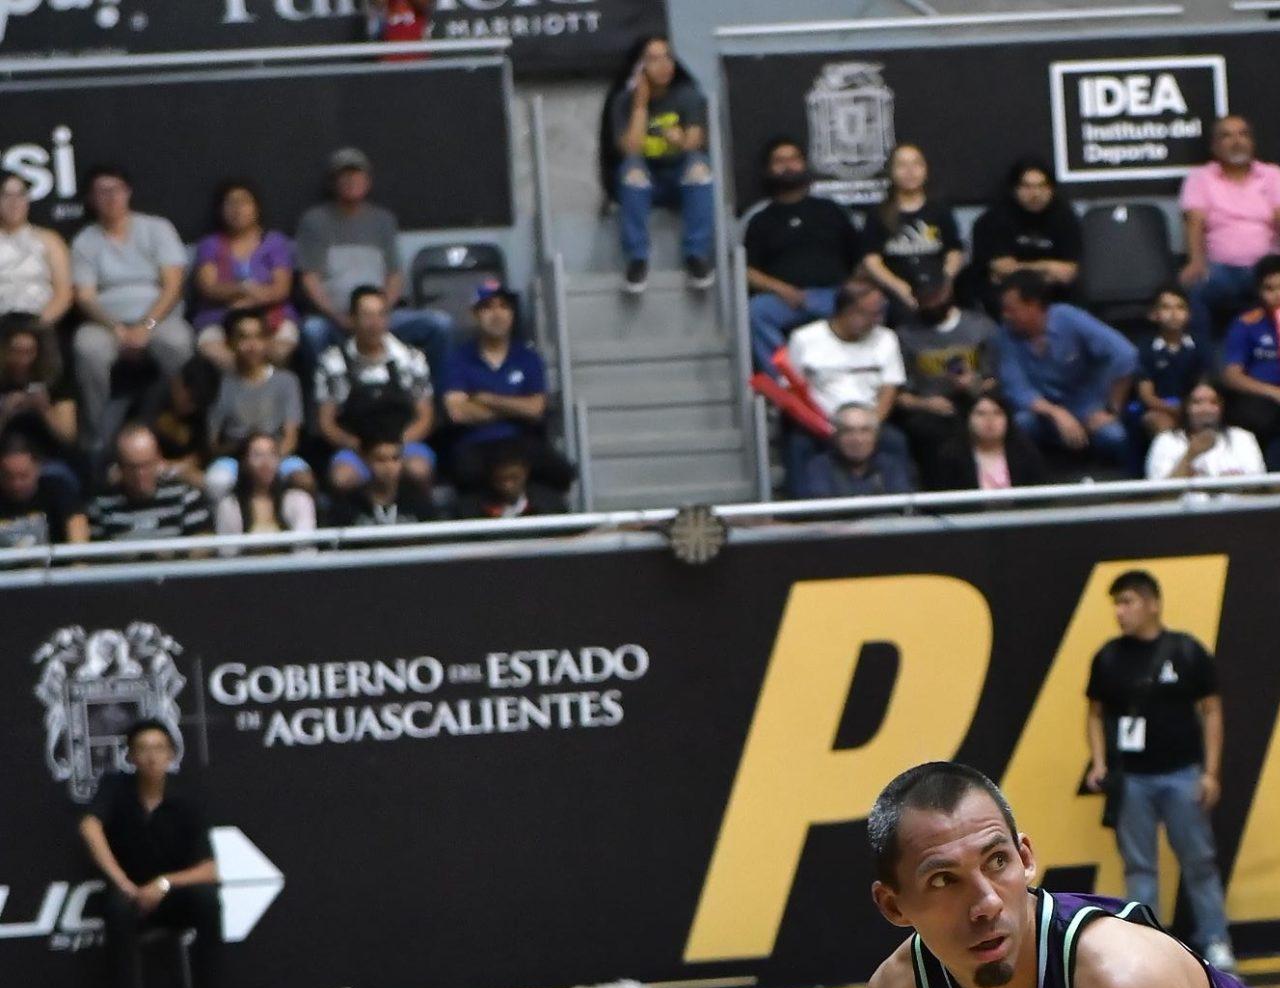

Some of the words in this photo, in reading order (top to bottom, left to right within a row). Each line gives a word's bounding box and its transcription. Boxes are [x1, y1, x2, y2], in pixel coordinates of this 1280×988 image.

[446, 11, 601, 37] MARRIOTT
[1079, 73, 1188, 118] IDEA
[1083, 142, 1169, 164] Deporte
[208, 655, 444, 705] GOBIERNO
[486, 644, 650, 689] ESTADO
[264, 689, 624, 748] AGUASCALIENTES
